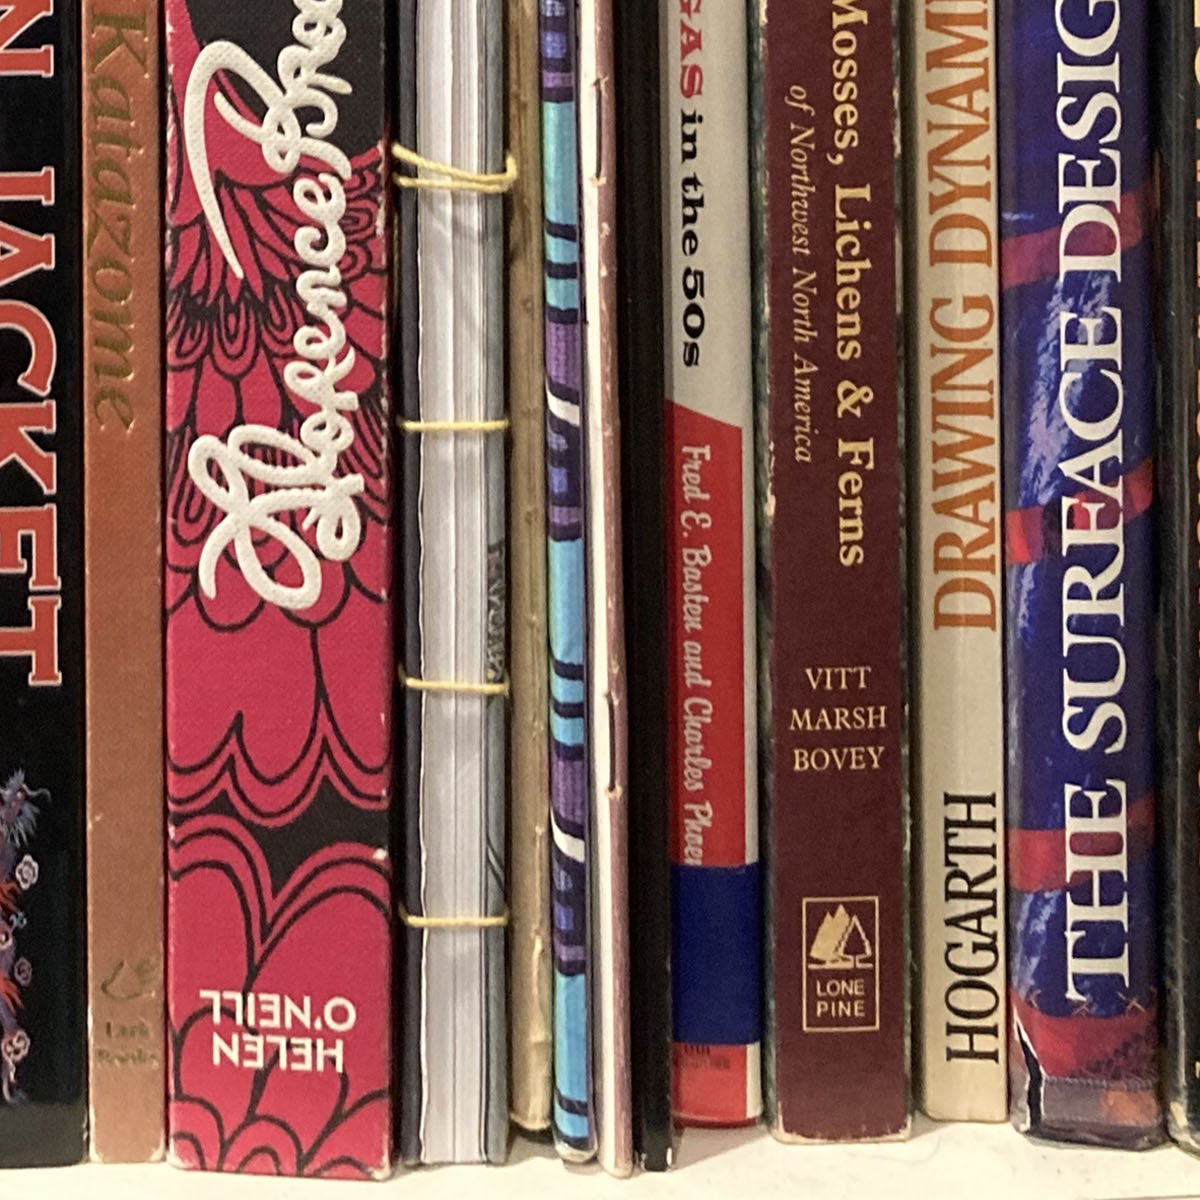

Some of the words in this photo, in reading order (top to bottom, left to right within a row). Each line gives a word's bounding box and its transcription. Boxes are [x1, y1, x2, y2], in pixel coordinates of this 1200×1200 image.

[679, 108, 703, 162] in
[782, 86, 814, 115] of
[88, 8, 149, 434] Katazome
[680, 176, 705, 257] the
[789, 114, 816, 253] Northwest
[791, 262, 818, 346] North
[833, 182, 872, 363] Lichens
[681, 265, 706, 368] 50s
[186, 172, 363, 611] Florence
[793, 353, 819, 464] America
[836, 379, 873, 420] &
[681, 443, 711, 500] Fred
[837, 437, 874, 567] Ferns
[929, 299, 998, 632] DRAWING
[681, 509, 712, 539] E.
[1058, 308, 1130, 754] SURFACE
[681, 545, 712, 632] Basten
[685, 640, 711, 688] and
[805, 666, 872, 690] VITT
[683, 696, 713, 792] Charles
[790, 706, 887, 730] MARSH
[793, 746, 885, 771] BOVEY
[943, 792, 1001, 1065] HOGARTH
[1064, 779, 1131, 1002] THE
[200, 990, 356, 1031] O'NEILL
[816, 978, 866, 998] LONE
[816, 1000, 866, 1018] PINE
[213, 1032, 344, 1073] HELEN
